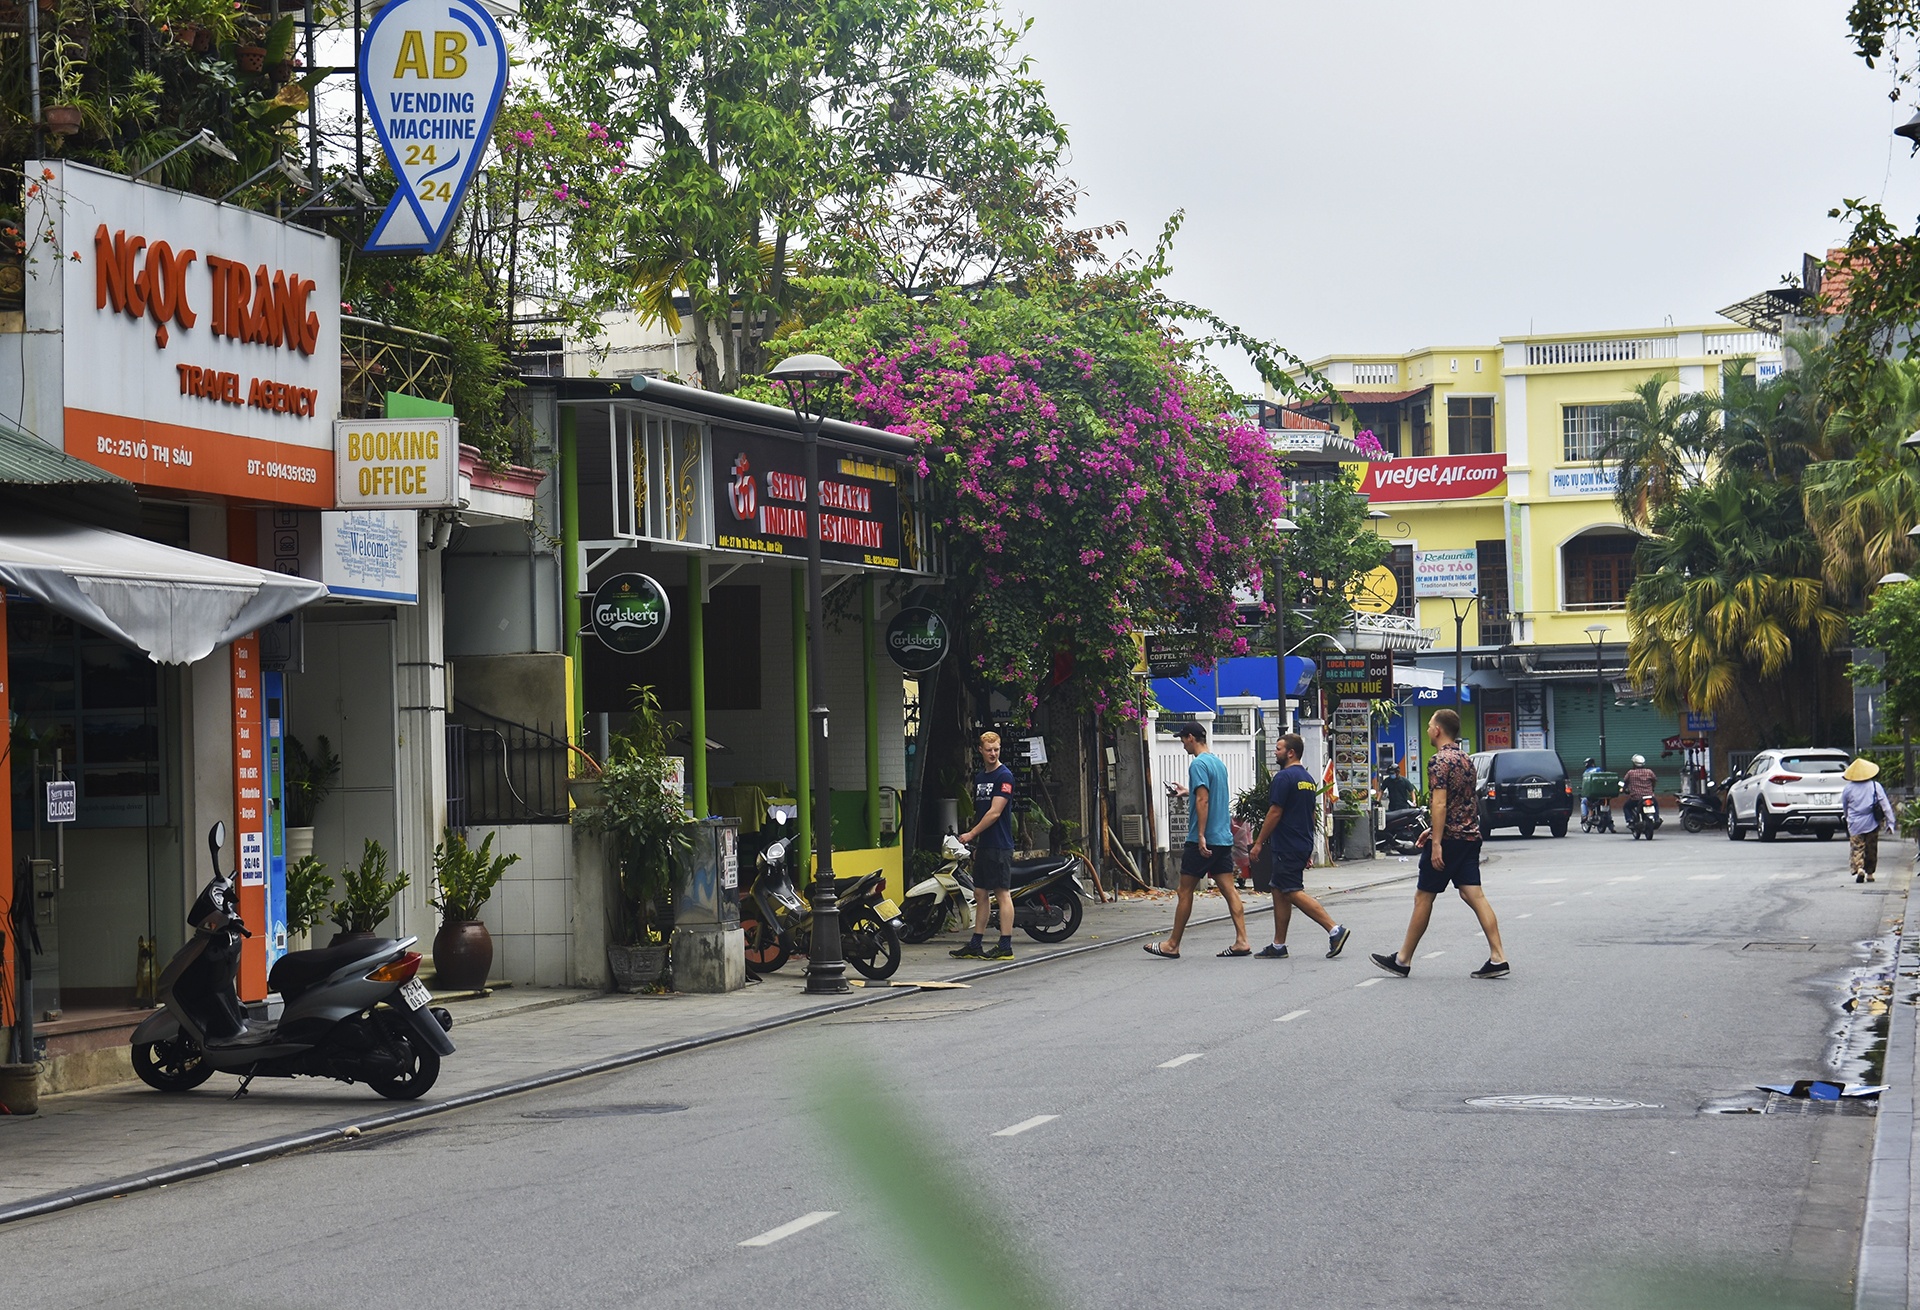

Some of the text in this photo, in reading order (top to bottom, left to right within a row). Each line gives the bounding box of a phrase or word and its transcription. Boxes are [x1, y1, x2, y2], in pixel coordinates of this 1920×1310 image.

[394, 30, 468, 79] AB
[390, 92, 474, 113] VENDING
[389, 119, 476, 140] MACHINE
[404, 144, 438, 166] 24
[419, 180, 452, 203] 24
[95, 224, 320, 355] NGỌC TRANG
[176, 364, 318, 417] TRAVEL AGENCY
[118, 439, 132, 458] 25
[132, 439, 148, 460] VÕ
[152, 444, 169, 468] THỊ
[173, 445, 192, 467] SÁU
[348, 430, 438, 462] BOOKING
[266, 462, 317, 484] 0914351359
[358, 466, 428, 496] OFFICE
[767, 471, 807, 502] SHIV
[760, 506, 883, 548] INDIAN ESTAURANT
[350, 532, 388, 558] Welcome
[1418, 562, 1444, 573] ÔNG
[596, 604, 658, 628] Carlsberg
[890, 630, 942, 650] Carlsberg
[1370, 666, 1388, 676] ood
[1418, 690, 1438, 699] ACB
[50, 789, 62, 800] Sorry
[50, 801, 74, 816] CLOSED
